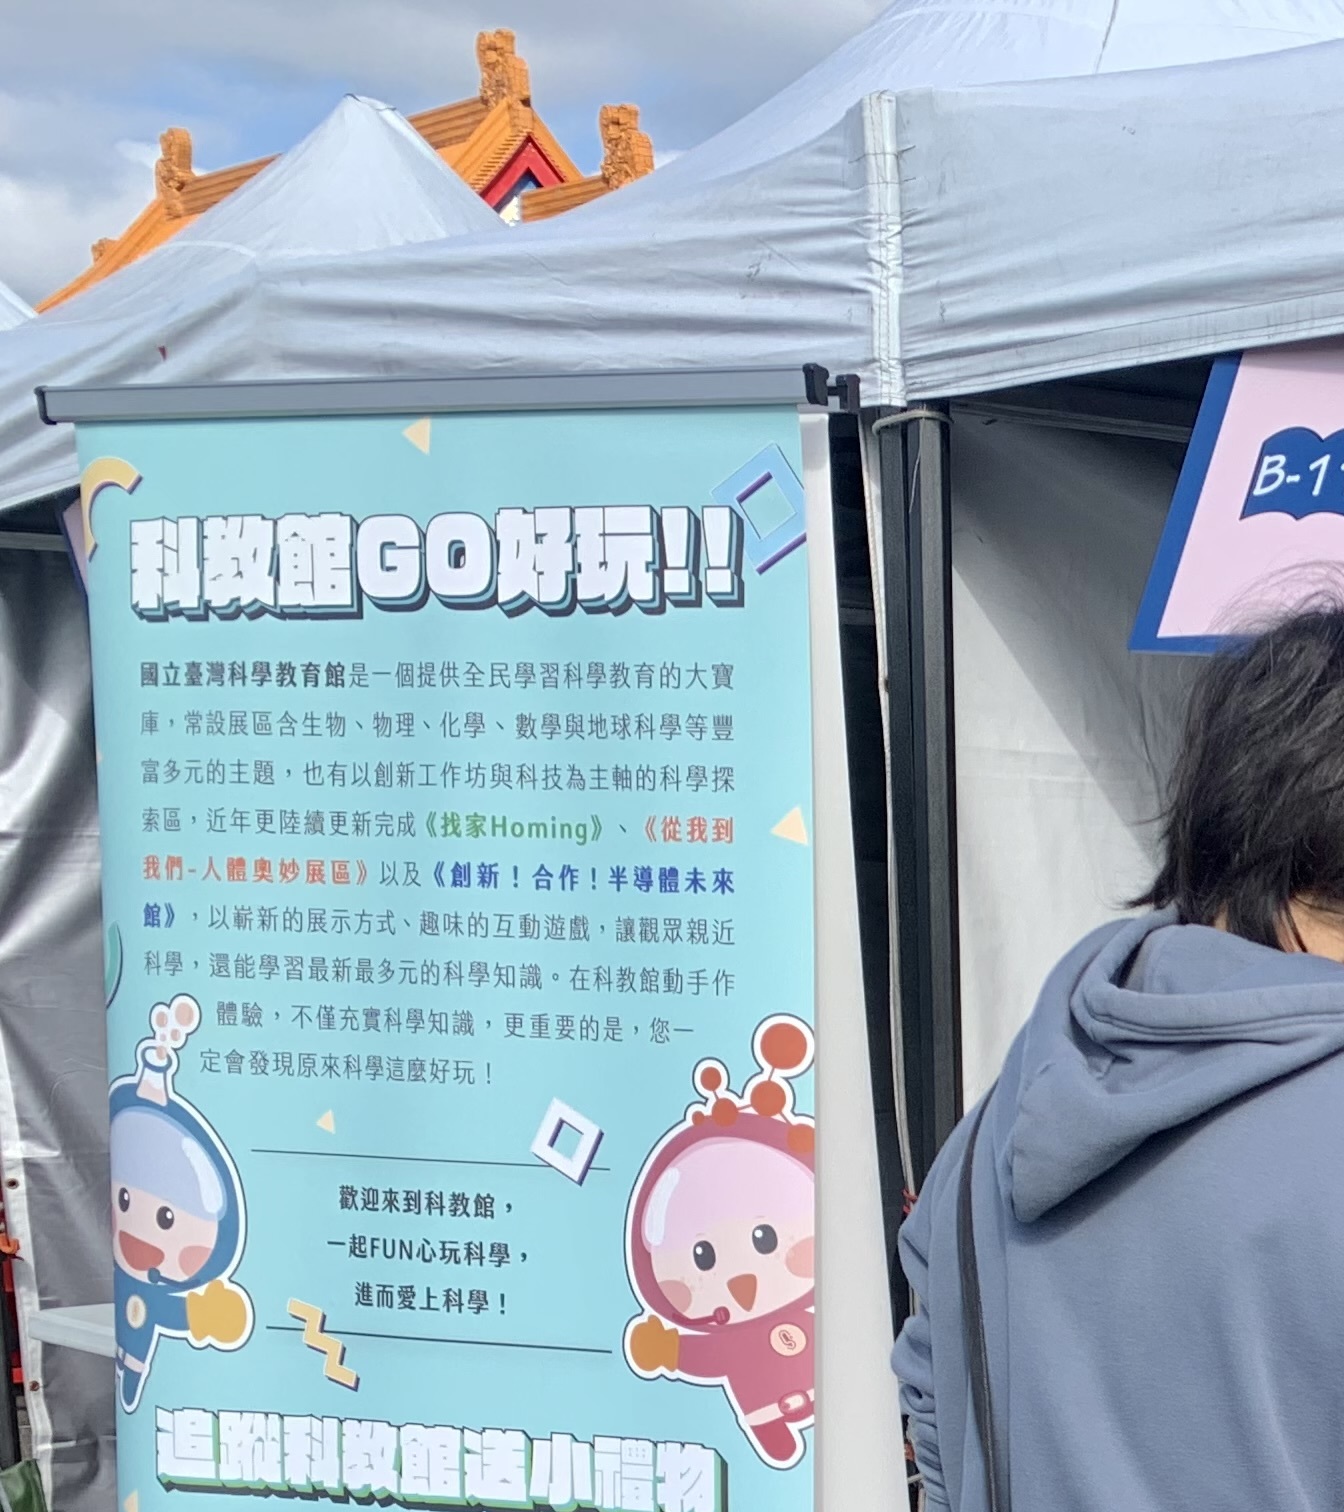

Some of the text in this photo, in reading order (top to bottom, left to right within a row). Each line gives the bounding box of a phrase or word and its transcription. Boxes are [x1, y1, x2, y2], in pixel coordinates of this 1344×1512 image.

[130, 505, 744, 621] 科教館GO好玩!!
[199, 1049, 492, 1084] 定會發現原來科學這麼好玩！
[338, 1185, 513, 1220] 歡迎來到科教館，
[327, 1234, 529, 1267] 一起FUN心玩科學，
[354, 1282, 508, 1316] 進而愛上科學！
